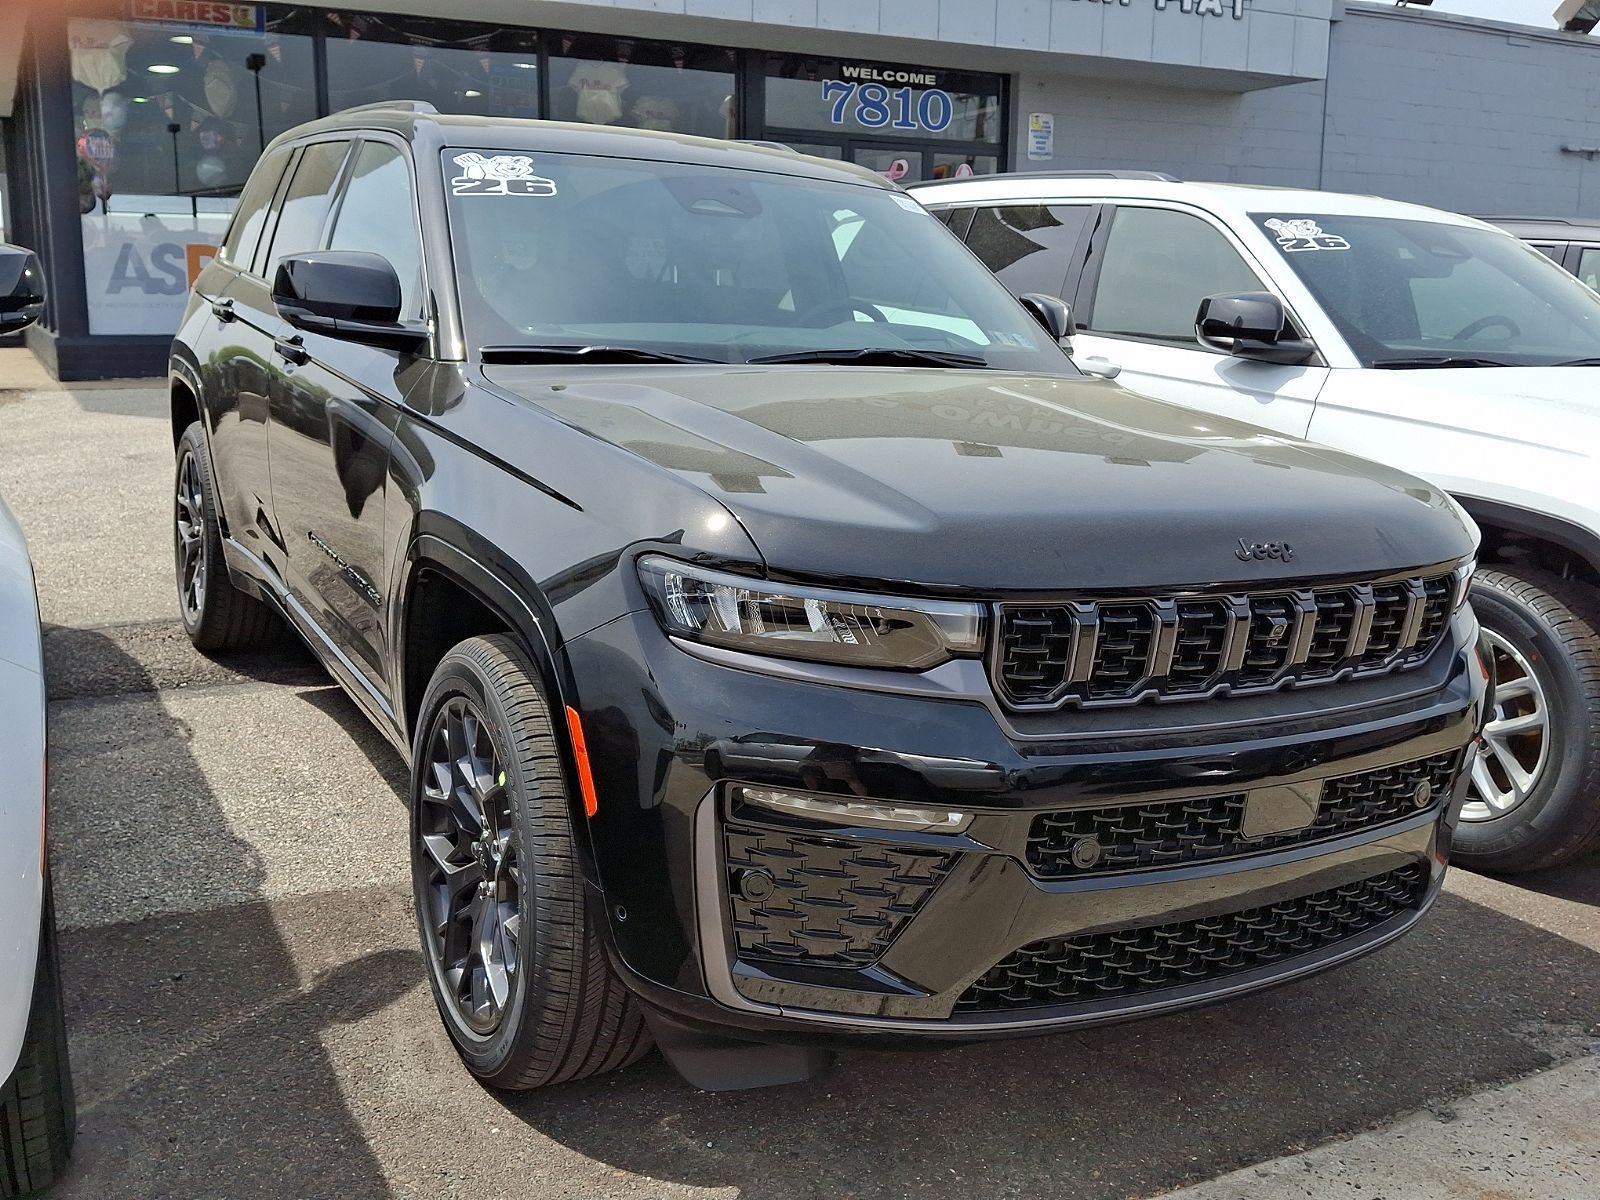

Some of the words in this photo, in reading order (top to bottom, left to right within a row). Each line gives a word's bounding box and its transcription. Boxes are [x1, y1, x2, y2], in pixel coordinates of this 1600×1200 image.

[842, 66, 937, 86] WELCOME
[821, 79, 953, 132] 7810
[451, 177, 557, 196] 26
[1276, 235, 1352, 252] 26
[1234, 537, 1293, 563] Jeep
